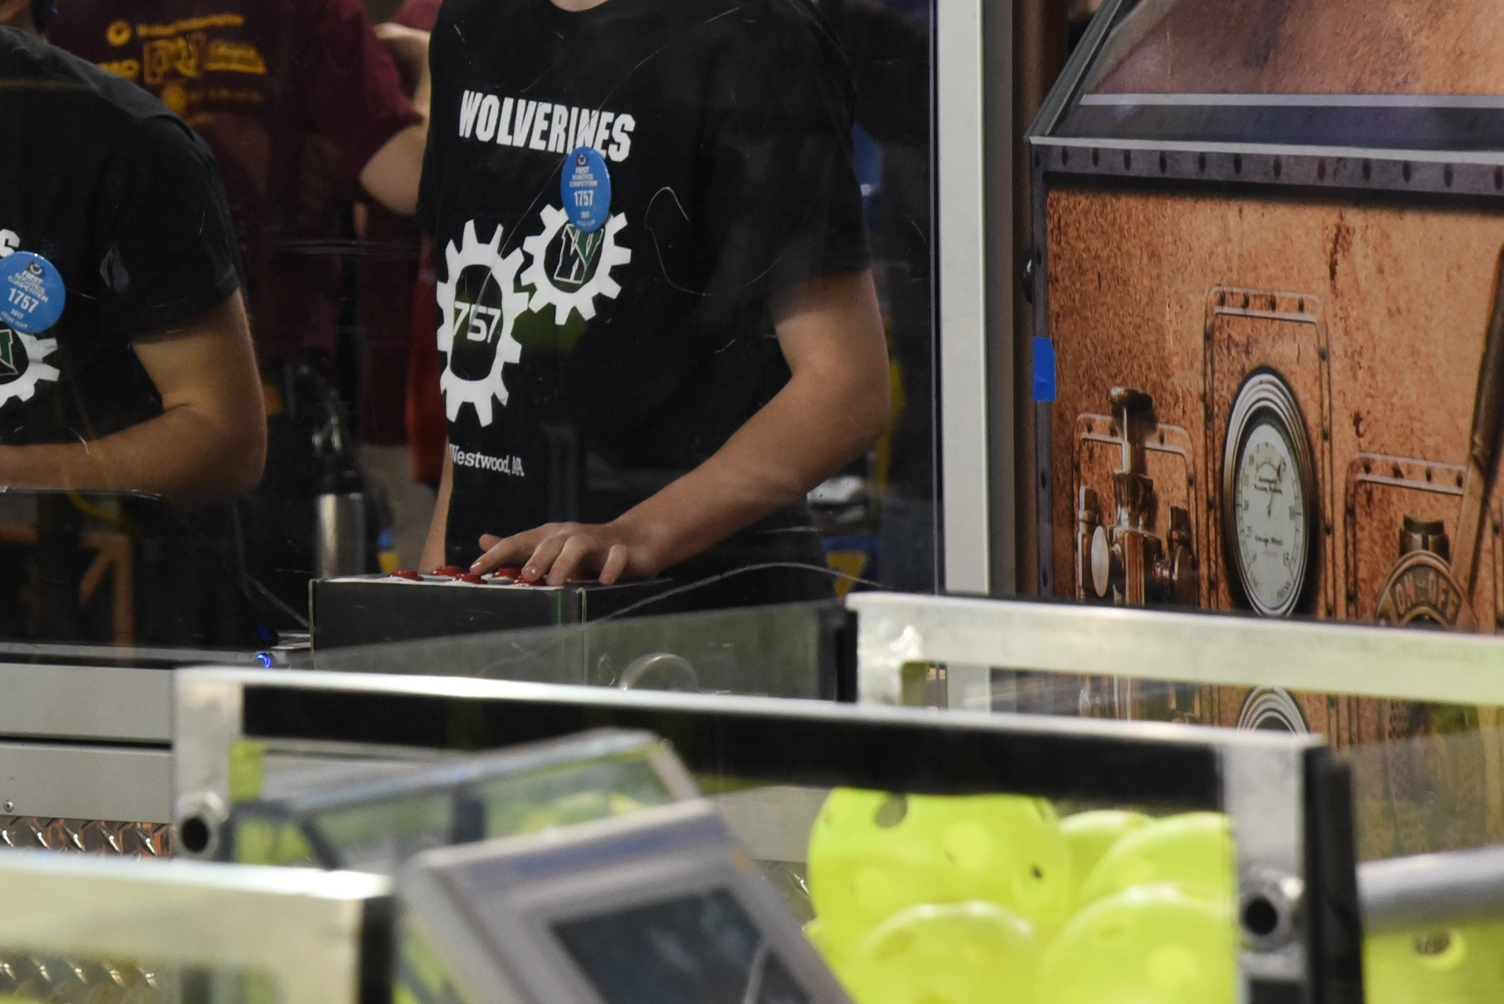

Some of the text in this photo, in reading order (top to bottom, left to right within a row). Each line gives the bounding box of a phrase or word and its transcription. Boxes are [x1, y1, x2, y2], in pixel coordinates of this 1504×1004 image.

[459, 89, 636, 163] WOLVERINES
[574, 190, 594, 207] 1757
[8, 288, 39, 313] 1757
[1396, 571, 1459, 621] ON OFF
